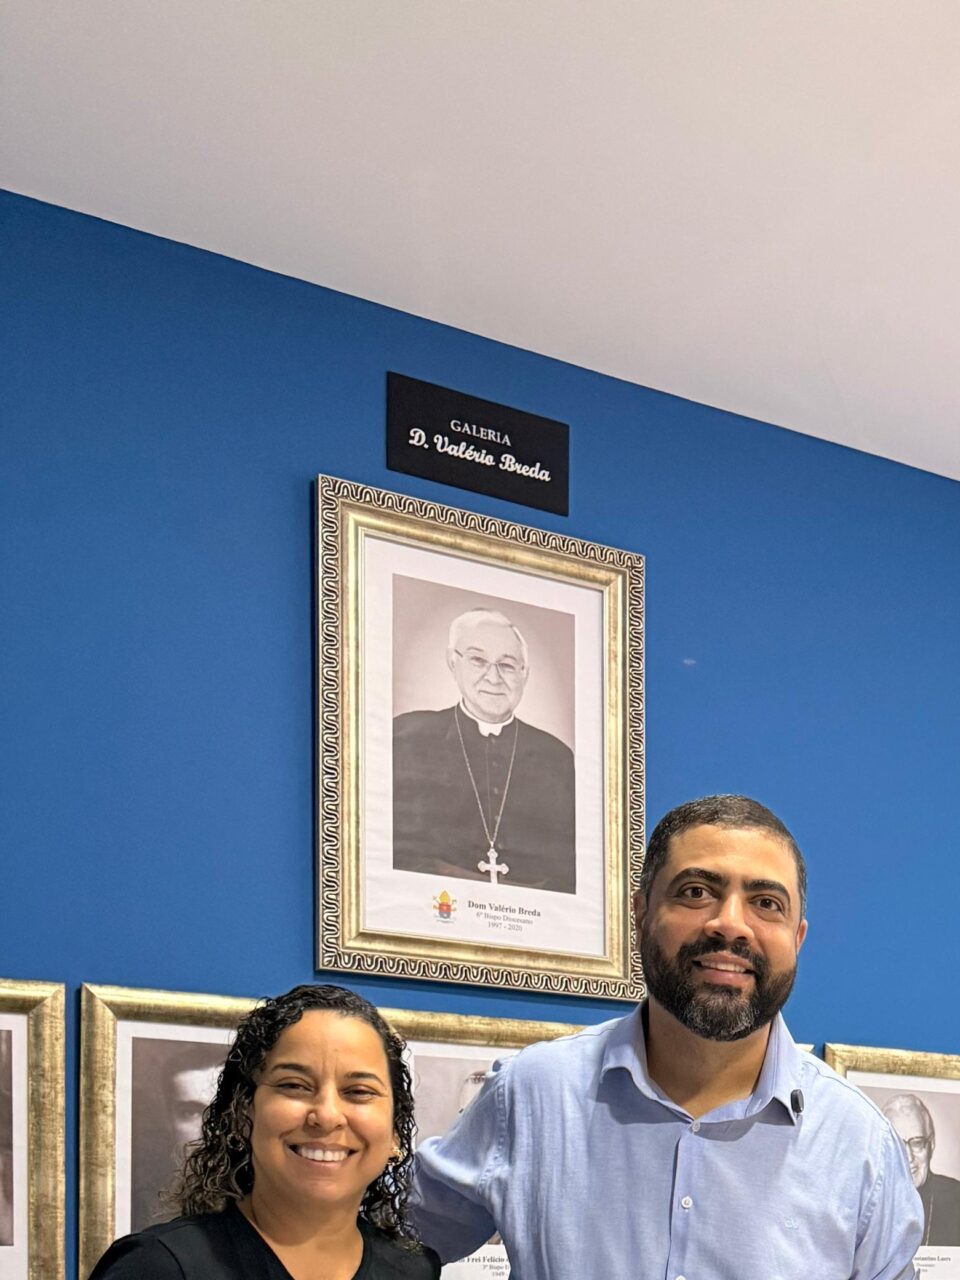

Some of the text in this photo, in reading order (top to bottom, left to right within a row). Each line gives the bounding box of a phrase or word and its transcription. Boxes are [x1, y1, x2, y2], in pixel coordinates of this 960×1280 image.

[450, 420, 511, 446] GALERIA
[408, 428, 551, 482] D. Valério Breda
[468, 900, 541, 917] Dom Valério Breda
